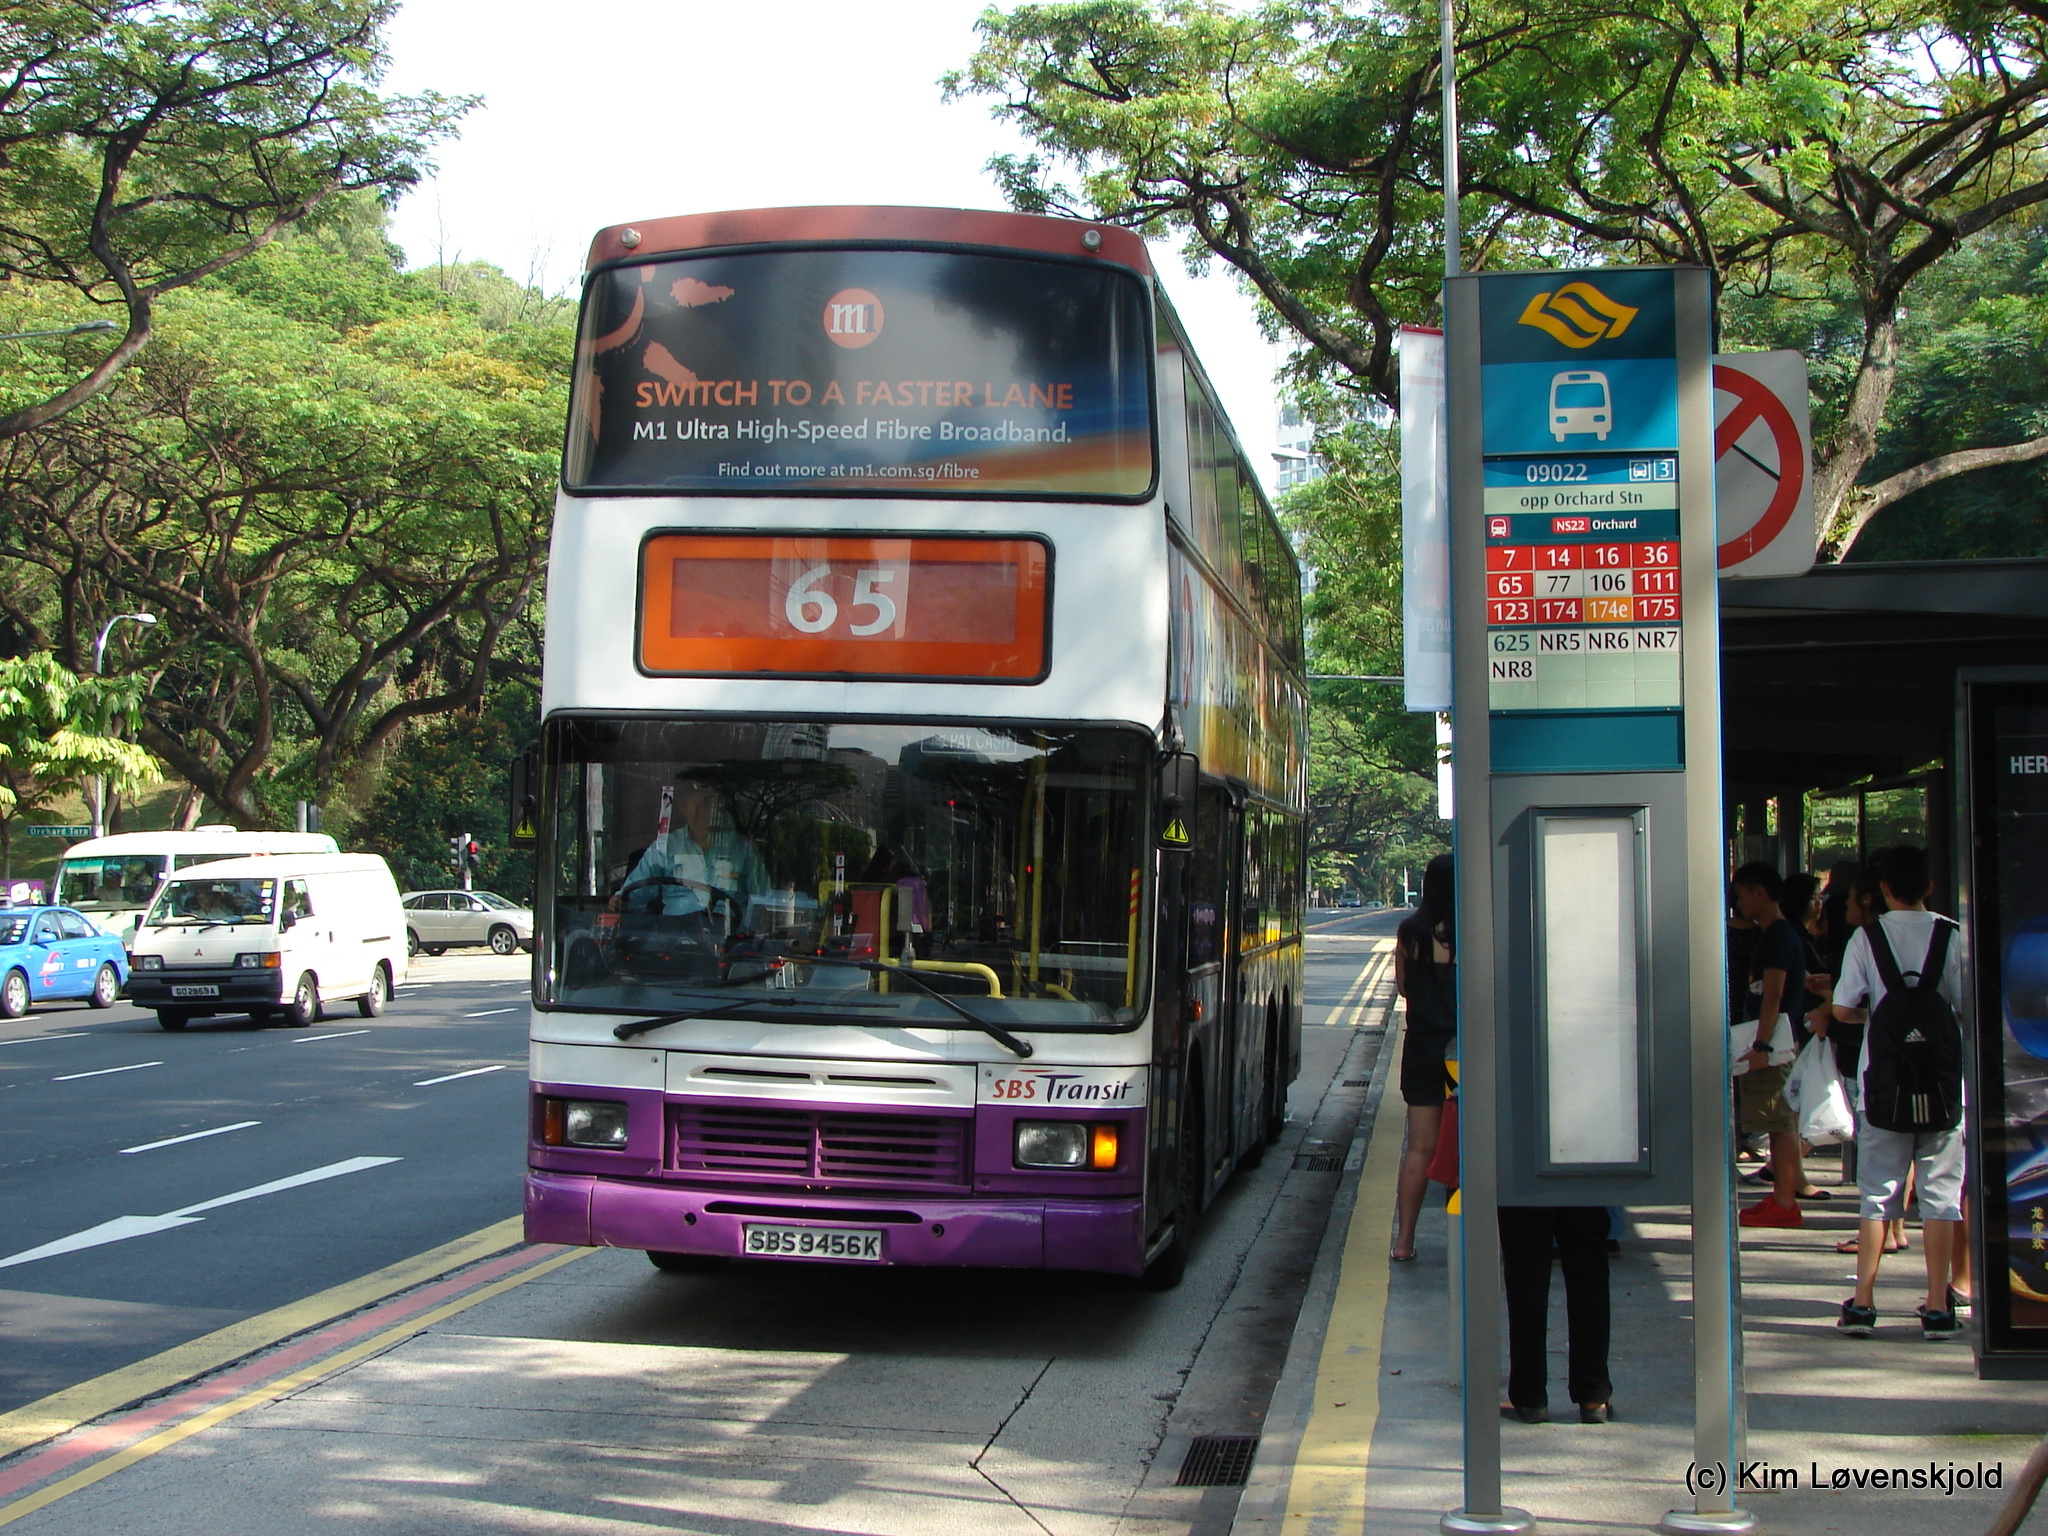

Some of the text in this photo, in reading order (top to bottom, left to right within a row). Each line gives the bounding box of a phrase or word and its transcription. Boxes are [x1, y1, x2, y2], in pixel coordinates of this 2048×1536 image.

[636, 380, 1074, 410] SWITCH TO A FASTER LANE
[633, 419, 1073, 444] M1 Ultra High-Speed Fibre Broadband.
[718, 462, 979, 480] Find out more at m1.com.sg/fibre
[1526, 463, 1588, 483] 09022
[1659, 462, 1670, 479] 3
[1520, 491, 1643, 509] opp Orchard Stn
[1556, 517, 1637, 531] NS22 Orchard
[1503, 546, 1668, 568] 7 14 16 36
[1498, 572, 1675, 595] 65 77 106 111
[785, 564, 898, 637] 65
[1493, 599, 1676, 621] 123 174 174e 175
[1494, 629, 1678, 652] 625 NR5 NR6 NR7
[1493, 659, 1532, 679] NR8
[30, 827, 89, 836] Orchard Turn
[993, 1075, 1134, 1103] SBS Transit
[751, 1231, 879, 1257] SBS9456K
